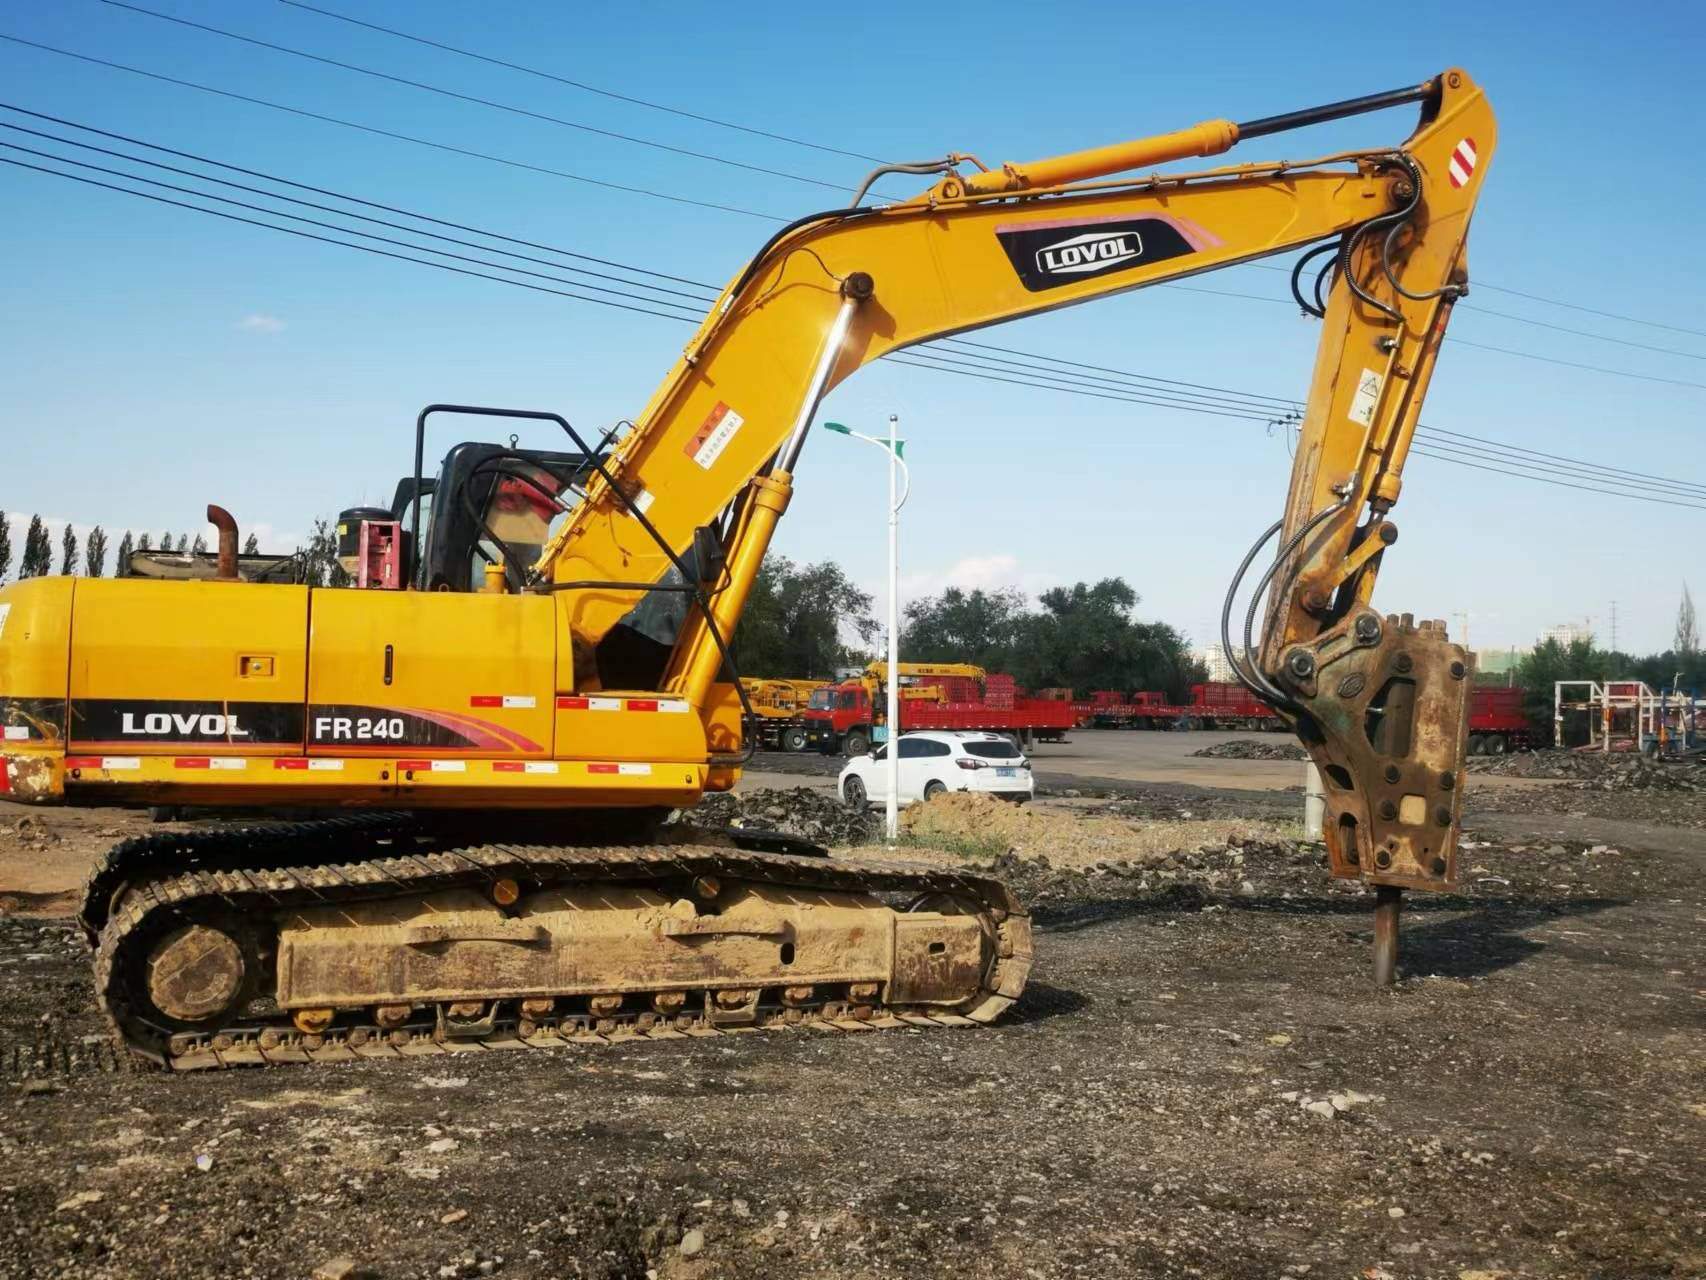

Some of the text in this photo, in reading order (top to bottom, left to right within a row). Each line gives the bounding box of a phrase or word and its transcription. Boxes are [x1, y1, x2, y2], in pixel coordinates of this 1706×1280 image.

[1045, 238, 1136, 270] LOVOL
[122, 713, 249, 736] LOVOL
[315, 717, 404, 739] FR 240
